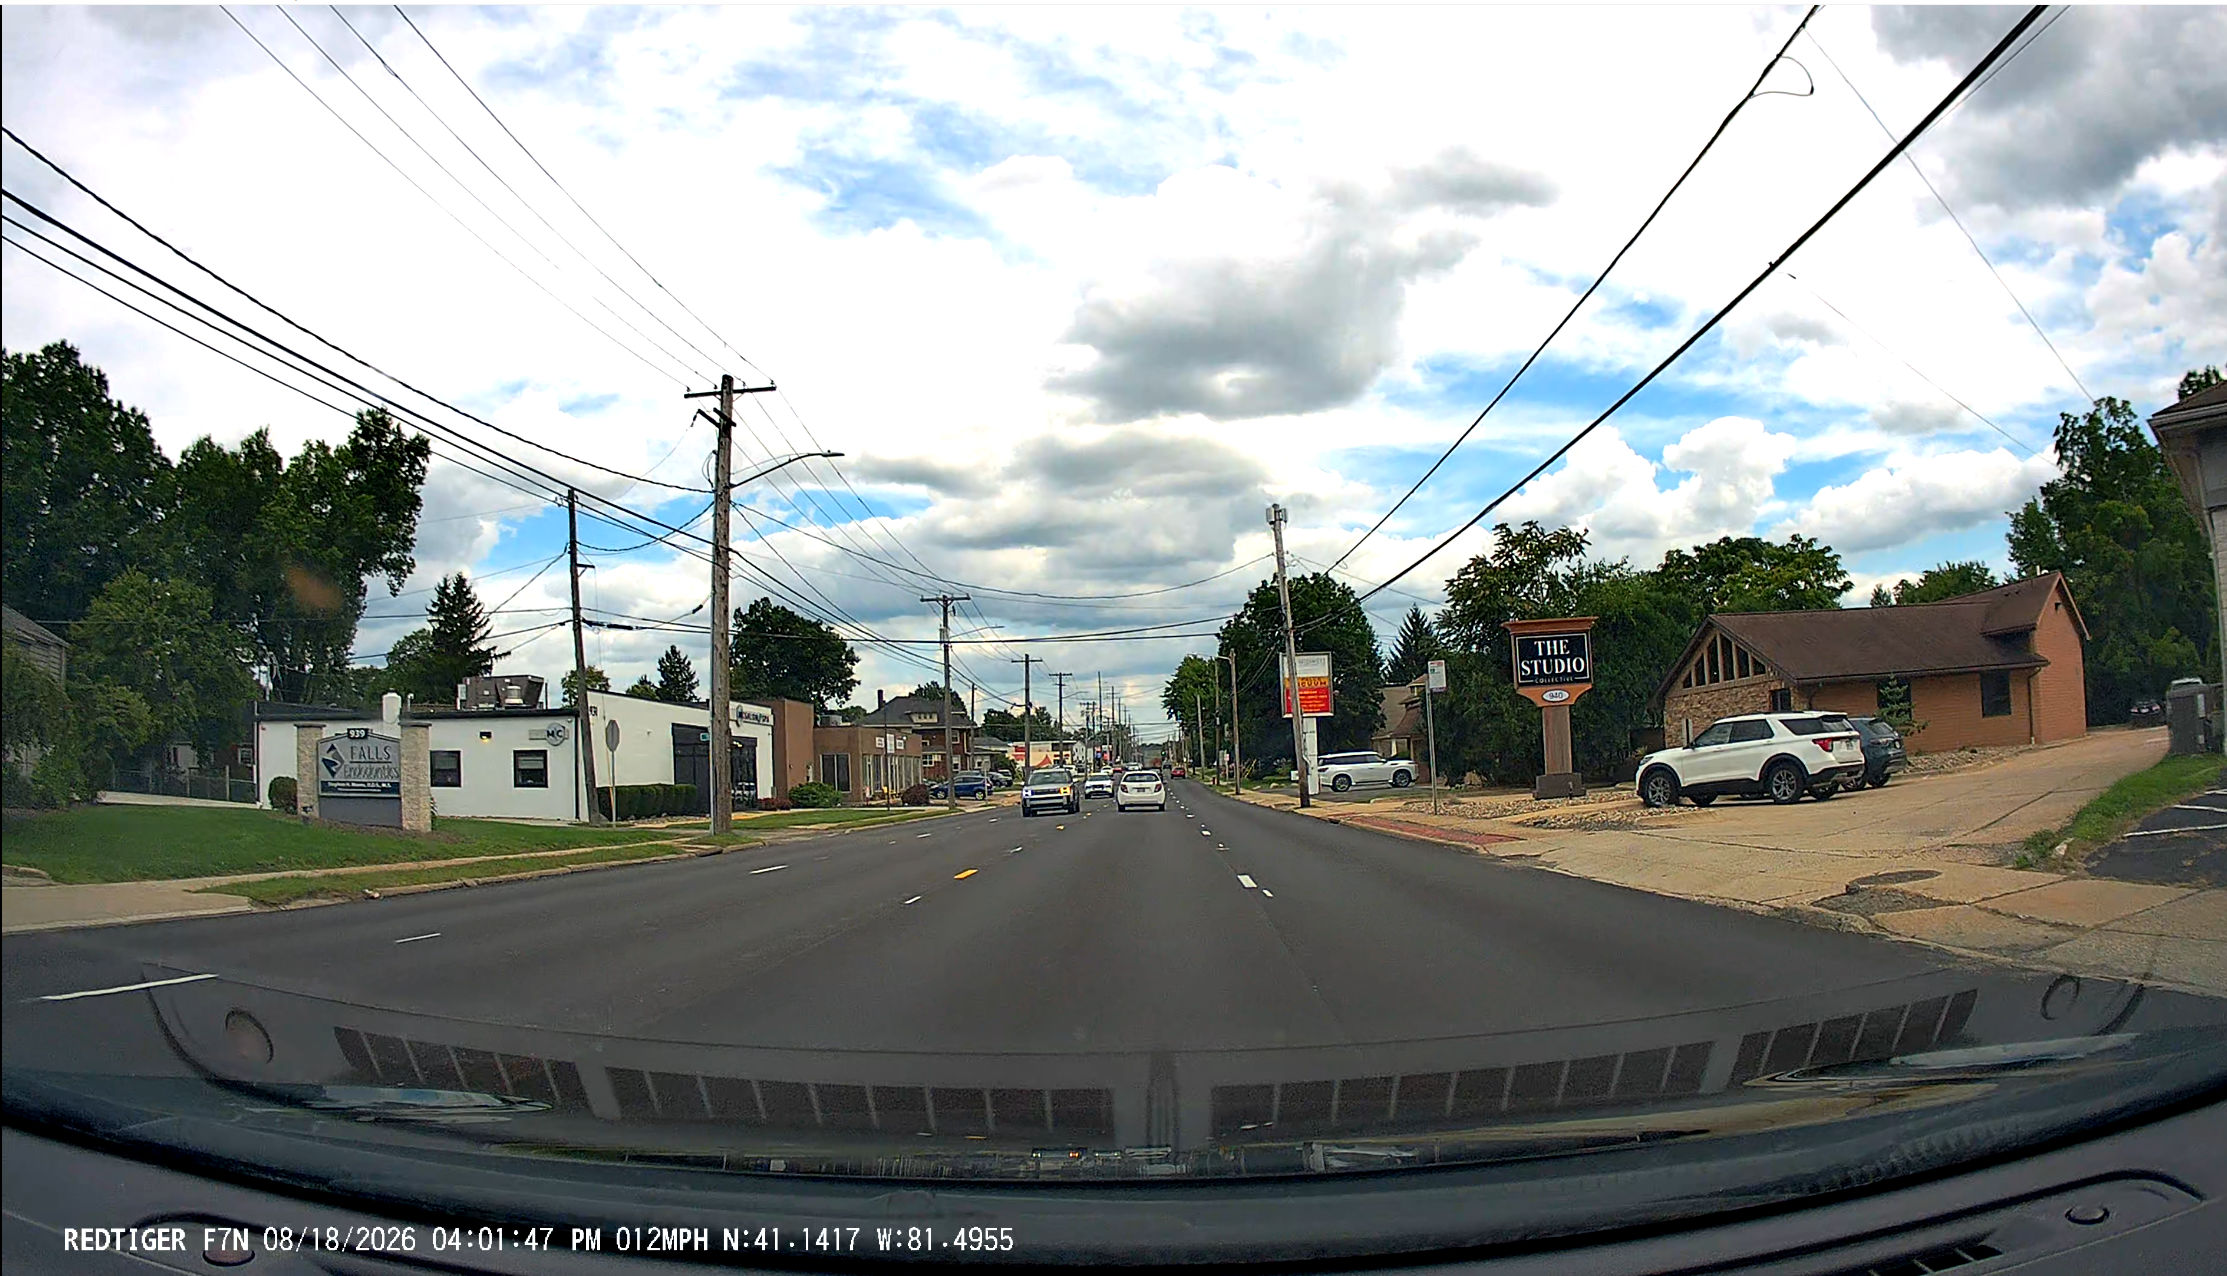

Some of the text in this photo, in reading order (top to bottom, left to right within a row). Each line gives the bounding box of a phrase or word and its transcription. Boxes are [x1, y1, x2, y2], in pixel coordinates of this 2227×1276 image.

[1534, 639, 1570, 656] THE
[1521, 657, 1585, 676] STUDIO
[1535, 676, 1573, 684] COLLECTIVE
[349, 729, 366, 738] 939
[350, 745, 392, 760] FALLS
